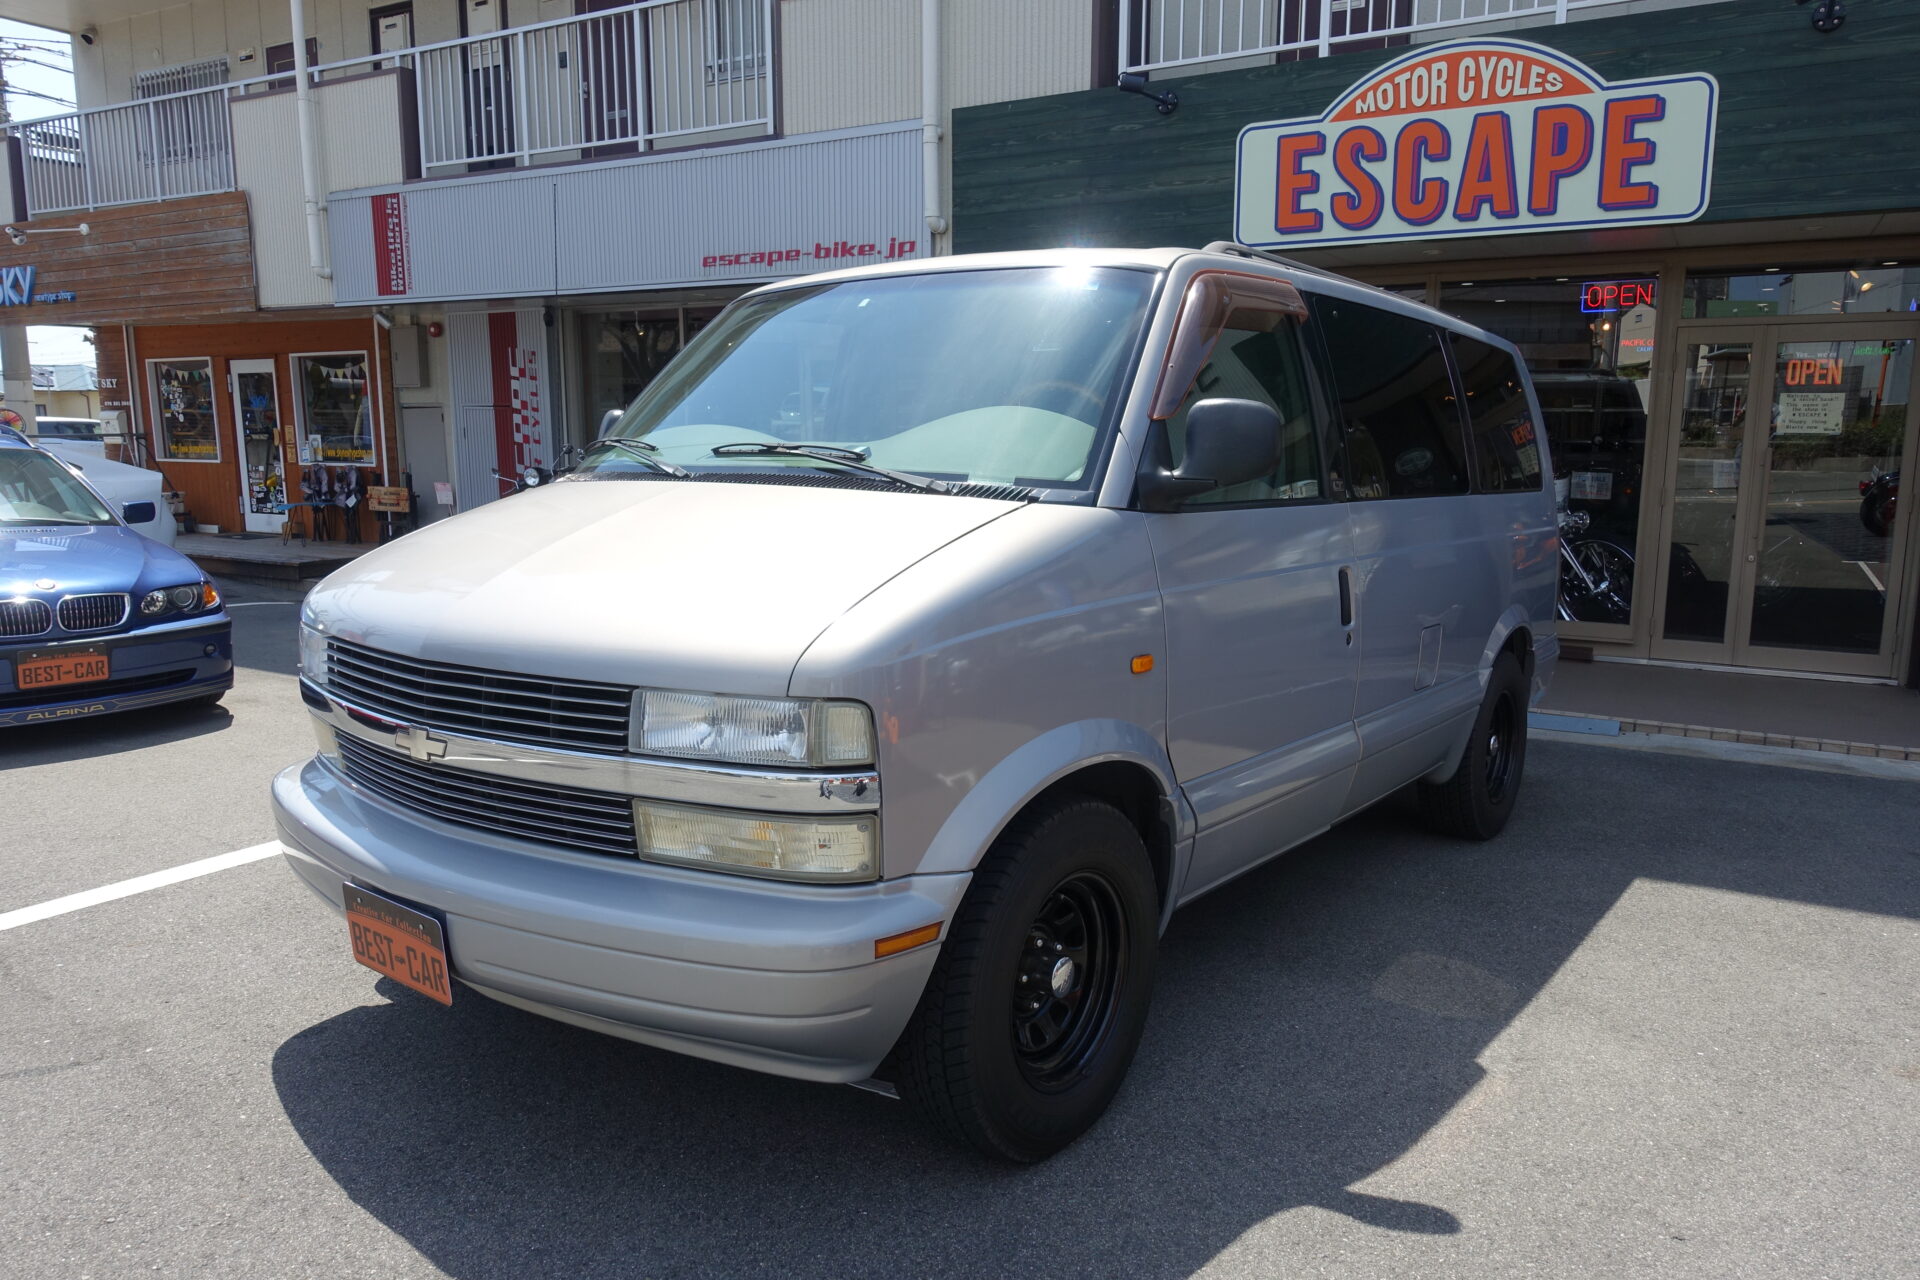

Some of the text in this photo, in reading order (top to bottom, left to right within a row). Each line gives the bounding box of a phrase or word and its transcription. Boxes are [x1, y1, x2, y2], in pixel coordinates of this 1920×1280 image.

[1355, 56, 1564, 114] MOTOR CYCLES
[1274, 94, 1666, 235] ESCAPE
[702, 237, 916, 267] escape-bike.jp
[1587, 284, 1653, 307] OPEN
[101, 378, 118, 388] SKY
[1786, 358, 1843, 385] OPEN
[22, 660, 106, 685] BEST-CAR
[27, 705, 104, 720] ALPINA
[381, 912, 393, 924] Car
[352, 921, 447, 996] BEST-CAR
